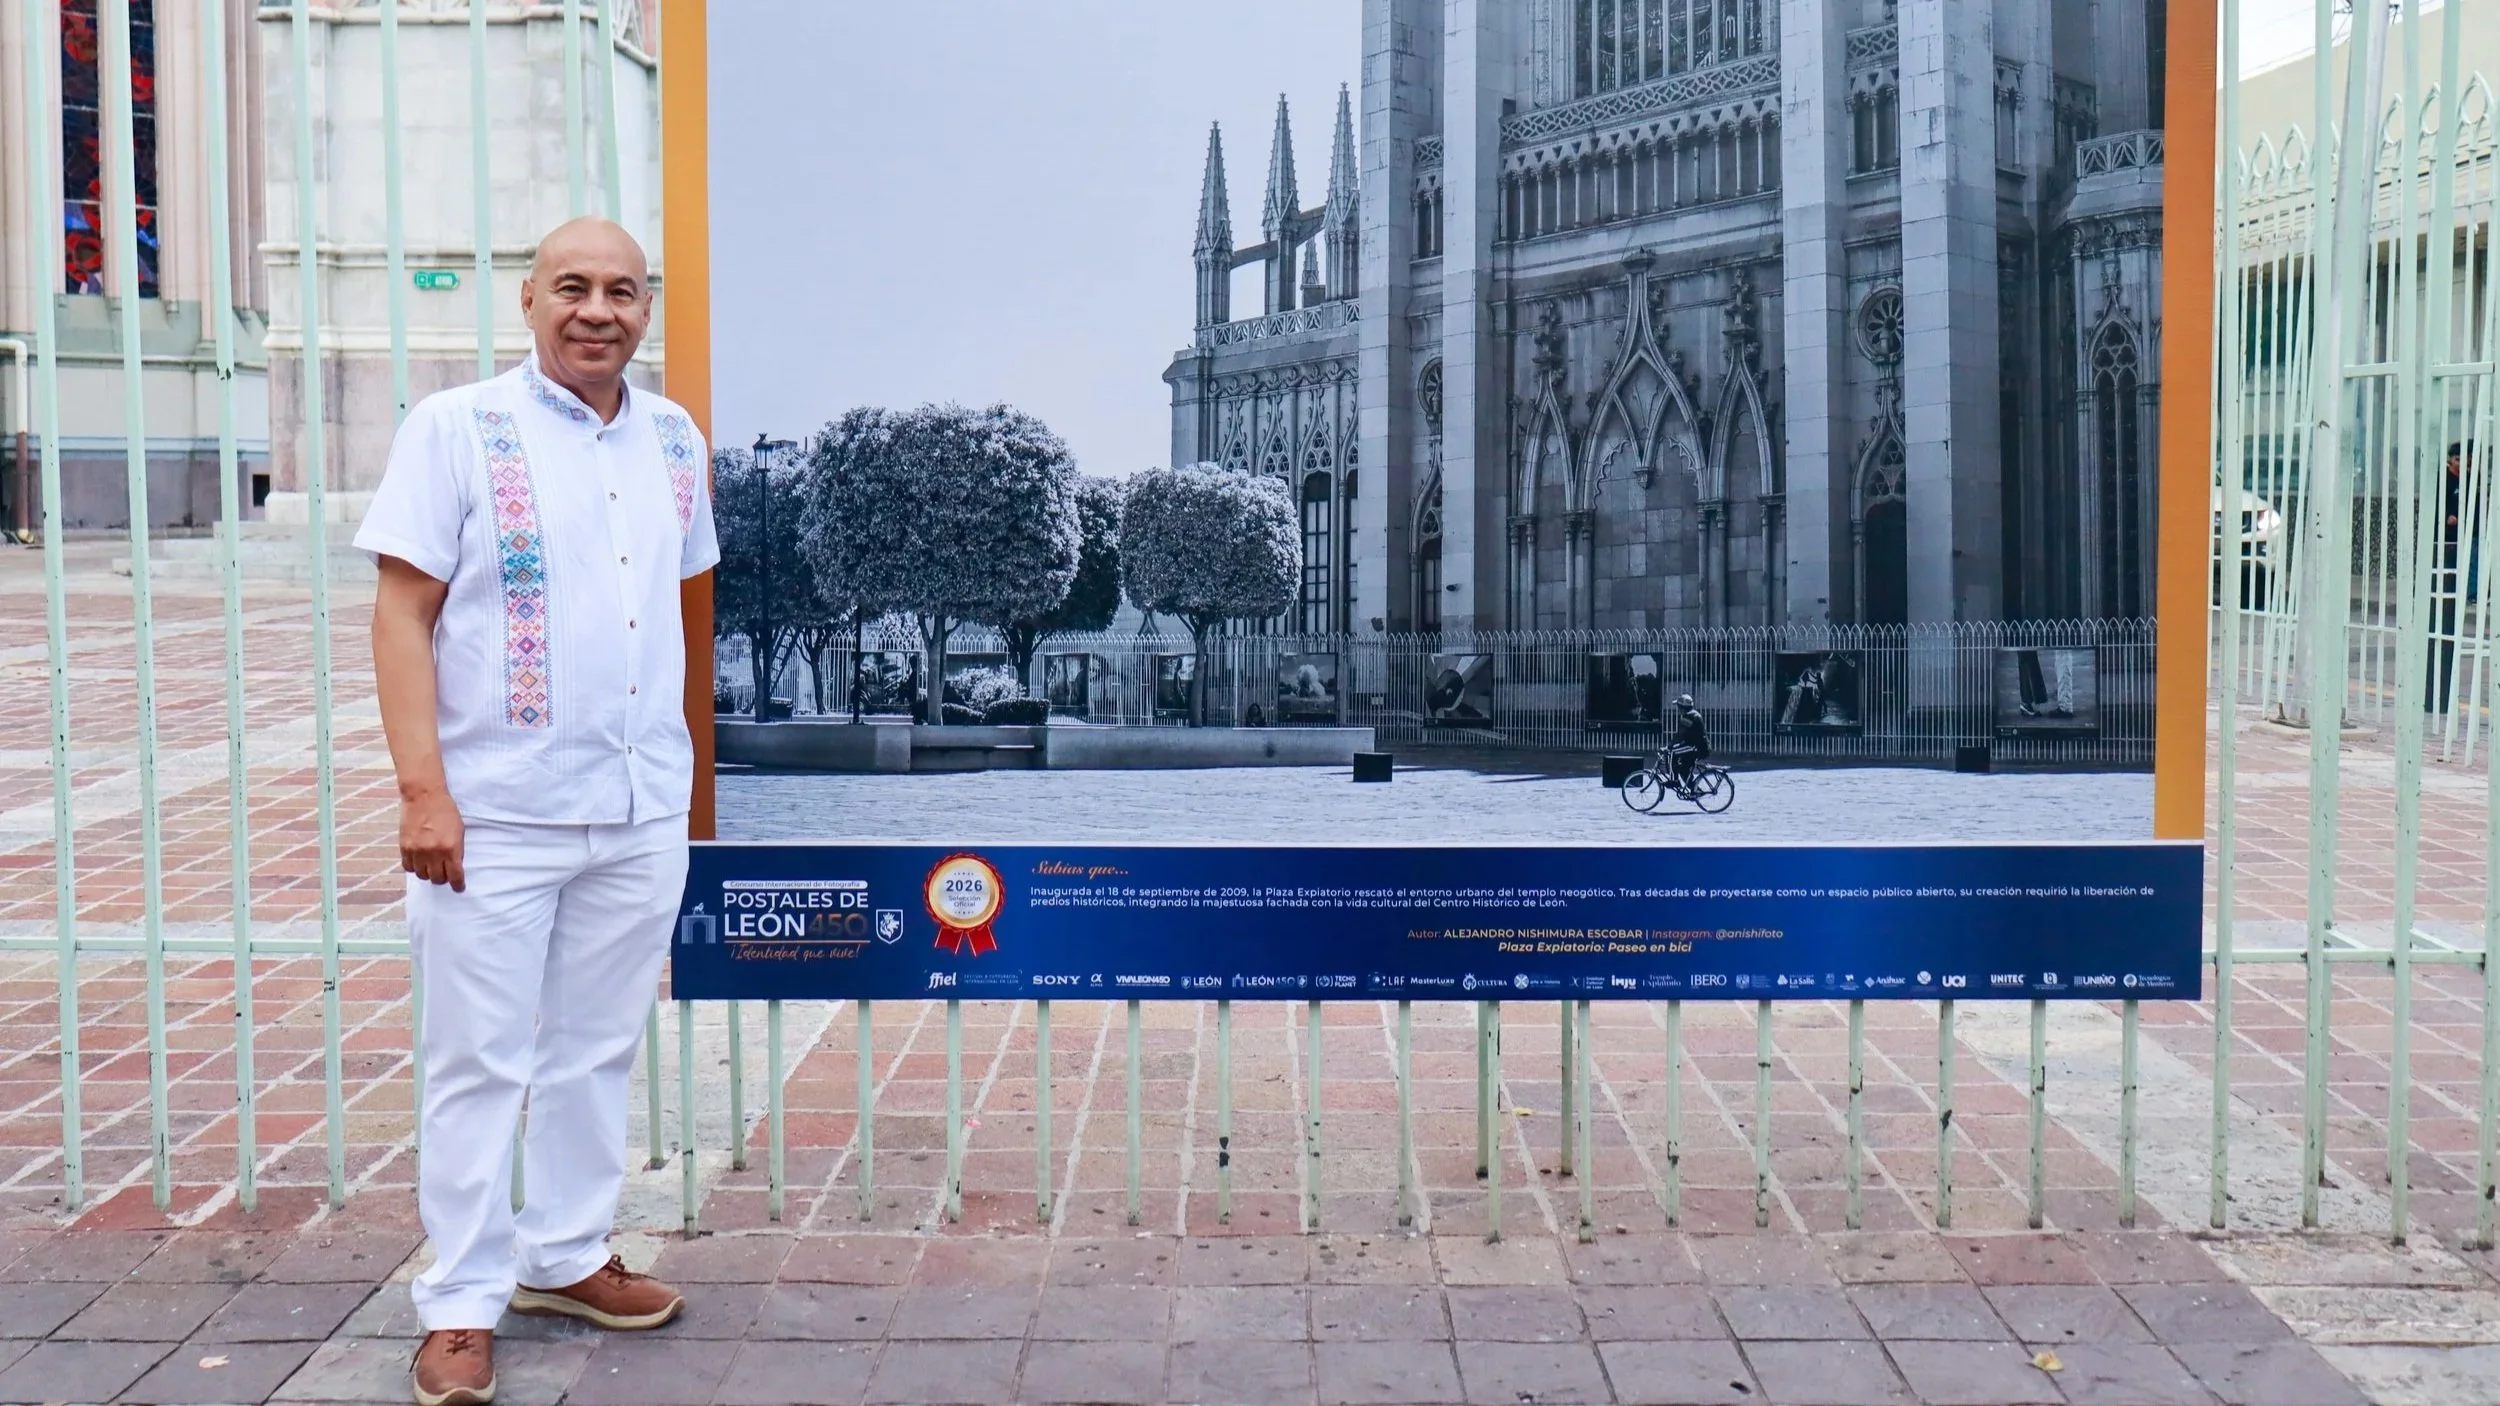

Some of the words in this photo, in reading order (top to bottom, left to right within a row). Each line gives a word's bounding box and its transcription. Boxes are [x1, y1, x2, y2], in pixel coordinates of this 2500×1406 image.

[1088, 866, 1129, 880] que...
[730, 880, 764, 889] Concurso
[765, 880, 812, 889] Internacional
[813, 880, 823, 889] de
[945, 879, 983, 892] 2026
[1031, 887, 1092, 899] Inaugurada
[1095, 887, 1105, 897] el
[1108, 887, 1119, 897] 18
[1122, 887, 1136, 897] de
[1139, 887, 1200, 900] septiembre
[1203, 887, 1218, 897] de
[1220, 888, 1250, 898] 2009,
[1252, 888, 1262, 897] la
[1265, 888, 1294, 897] Plaza
[1297, 888, 1353, 900] Expiatorio
[1354, 887, 1394, 897] rescató
[1397, 888, 1407, 897] el
[1409, 888, 1453, 897] entorno
[1455, 888, 1494, 897] urbano
[1498, 888, 1515, 897] del
[1517, 888, 1557, 900] templo
[1559, 886, 1616, 900] neogótico.
[1618, 888, 1642, 897] Tras
[1644, 887, 1690, 897] décadas
[1692, 888, 1707, 897] de
[1709, 888, 1774, 900] proyectarse
[1776, 889, 1808, 897] como
[1810, 889, 1825, 897] un
[1827, 888, 1870, 899] espacio
[1872, 886, 1913, 899] público
[1915, 887, 1957, 898] abierto,
[1959, 888, 1973, 896] su
[1975, 886, 2023, 897] creación
[2025, 886, 2068, 899] requirió
[2070, 886, 2081, 896] la
[2083, 886, 2137, 896] liberación
[2139, 886, 2155, 896] de
[724, 892, 833, 909] POSTALES
[839, 892, 869, 909] DE
[1031, 897, 1071, 908] predios
[1073, 897, 1127, 907] históricos,
[1129, 897, 1189, 909] integrando
[1190, 897, 1200, 907] la
[1203, 897, 1264, 909] majestuosa
[1266, 897, 1309, 907] fachada
[1311, 899, 1332, 907] con
[1334, 897, 1344, 907] la
[1346, 897, 1368, 907] vida
[1370, 897, 1412, 907] cultural
[1414, 897, 1431, 907] del
[1433, 897, 1470, 907] Centro
[1472, 897, 1521, 907] Histórico
[1522, 897, 1537, 907] de
[1539, 897, 1568, 907] León.
[1407, 929, 1441, 939] Autor:
[1443, 929, 1515, 938] ALEJANDRO
[1517, 929, 1585, 938] NISHIMURA
[1586, 929, 1643, 939] ESCOBAR
[1651, 929, 1714, 942] Instagram:
[1715, 927, 1784, 941] @anishifoto
[802, 948, 826, 963] que
[829, 943, 861, 960] vive!
[1497, 941, 1534, 953] Plaza
[1536, 941, 1605, 954] Expiatorio:
[1607, 941, 1647, 953] Paseo
[1649, 944, 1666, 953] en
[1668, 941, 1693, 953] bici
[1032, 975, 1081, 985] SONY
[1477, 979, 1508, 987] CULTURA
[1690, 974, 1728, 986] IBERO
[1789, 977, 1798, 985] La
[1798, 976, 1815, 986] Salle
[1990, 974, 2025, 984] UNITEC
